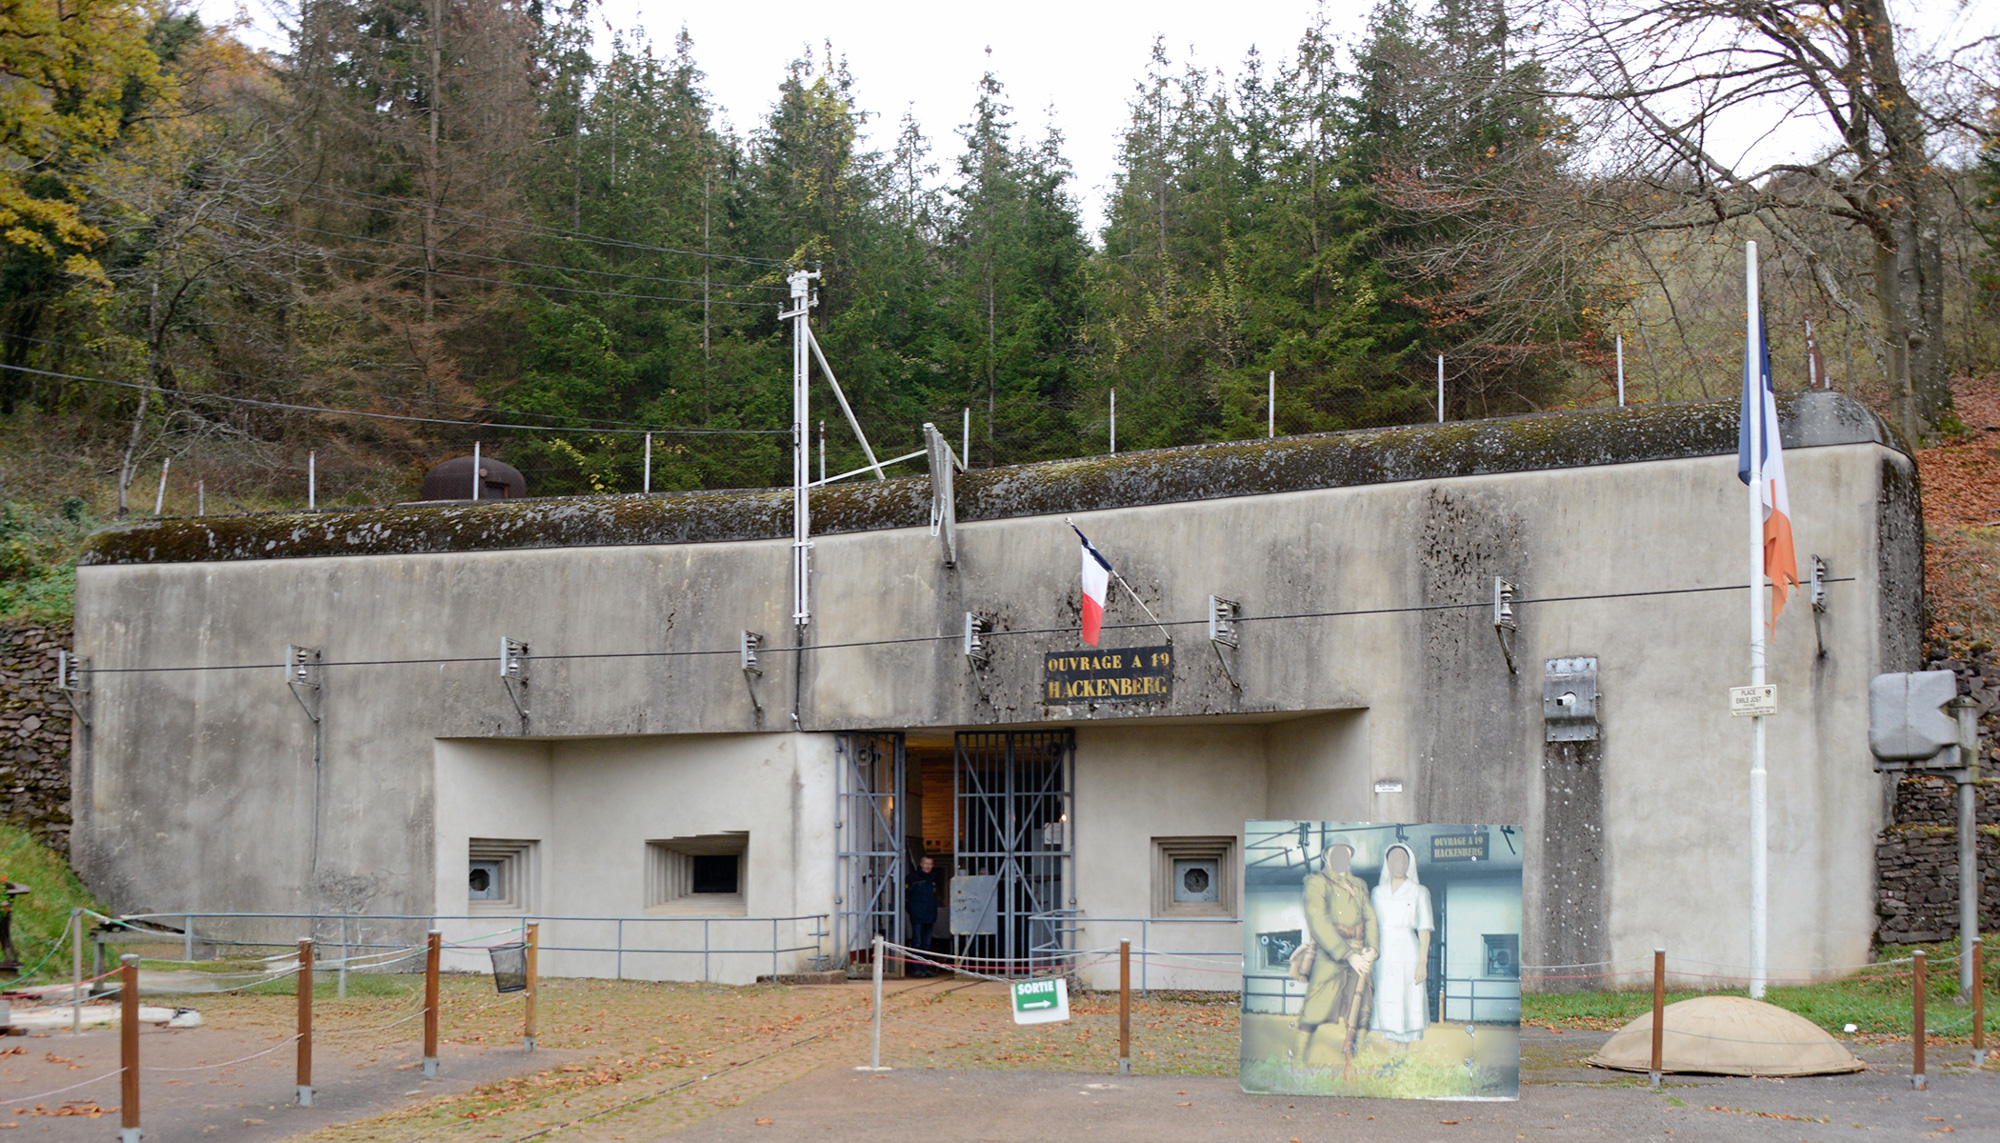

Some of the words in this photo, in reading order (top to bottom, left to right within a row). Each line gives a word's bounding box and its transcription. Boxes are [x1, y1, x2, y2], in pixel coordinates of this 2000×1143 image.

[1048, 654, 1122, 672] OUVRAGE
[1131, 654, 1142, 668] A
[1151, 652, 1170, 667] 19
[1048, 676, 1167, 698] HACKENBERG
[1741, 688, 1756, 696] PLACE
[1750, 695, 1761, 703] JOST
[1434, 836, 1466, 847] OUVRAGE
[1468, 836, 1474, 845] A
[1475, 836, 1483, 845] 19
[1434, 847, 1483, 858] HACKENBERG
[1017, 980, 1054, 995] SORTIE
